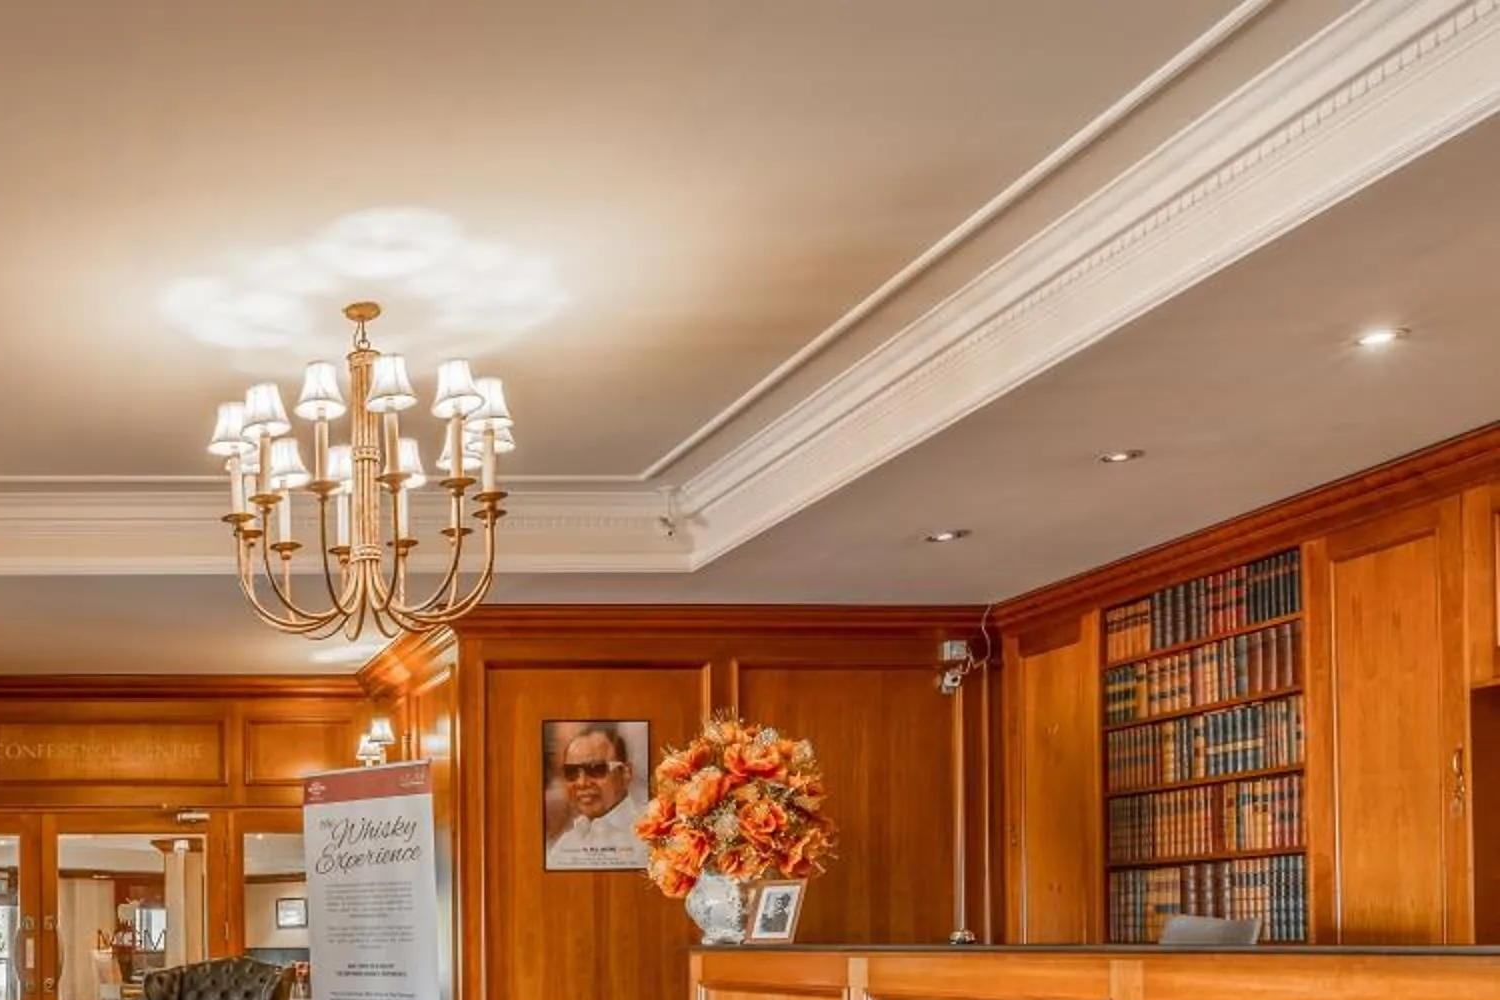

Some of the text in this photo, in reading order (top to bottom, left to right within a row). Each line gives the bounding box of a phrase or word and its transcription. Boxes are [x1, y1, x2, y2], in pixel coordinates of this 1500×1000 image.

[331, 815, 418, 849] Whisky
[315, 844, 422, 876] Experience
[97, 928, 167, 951] MM
